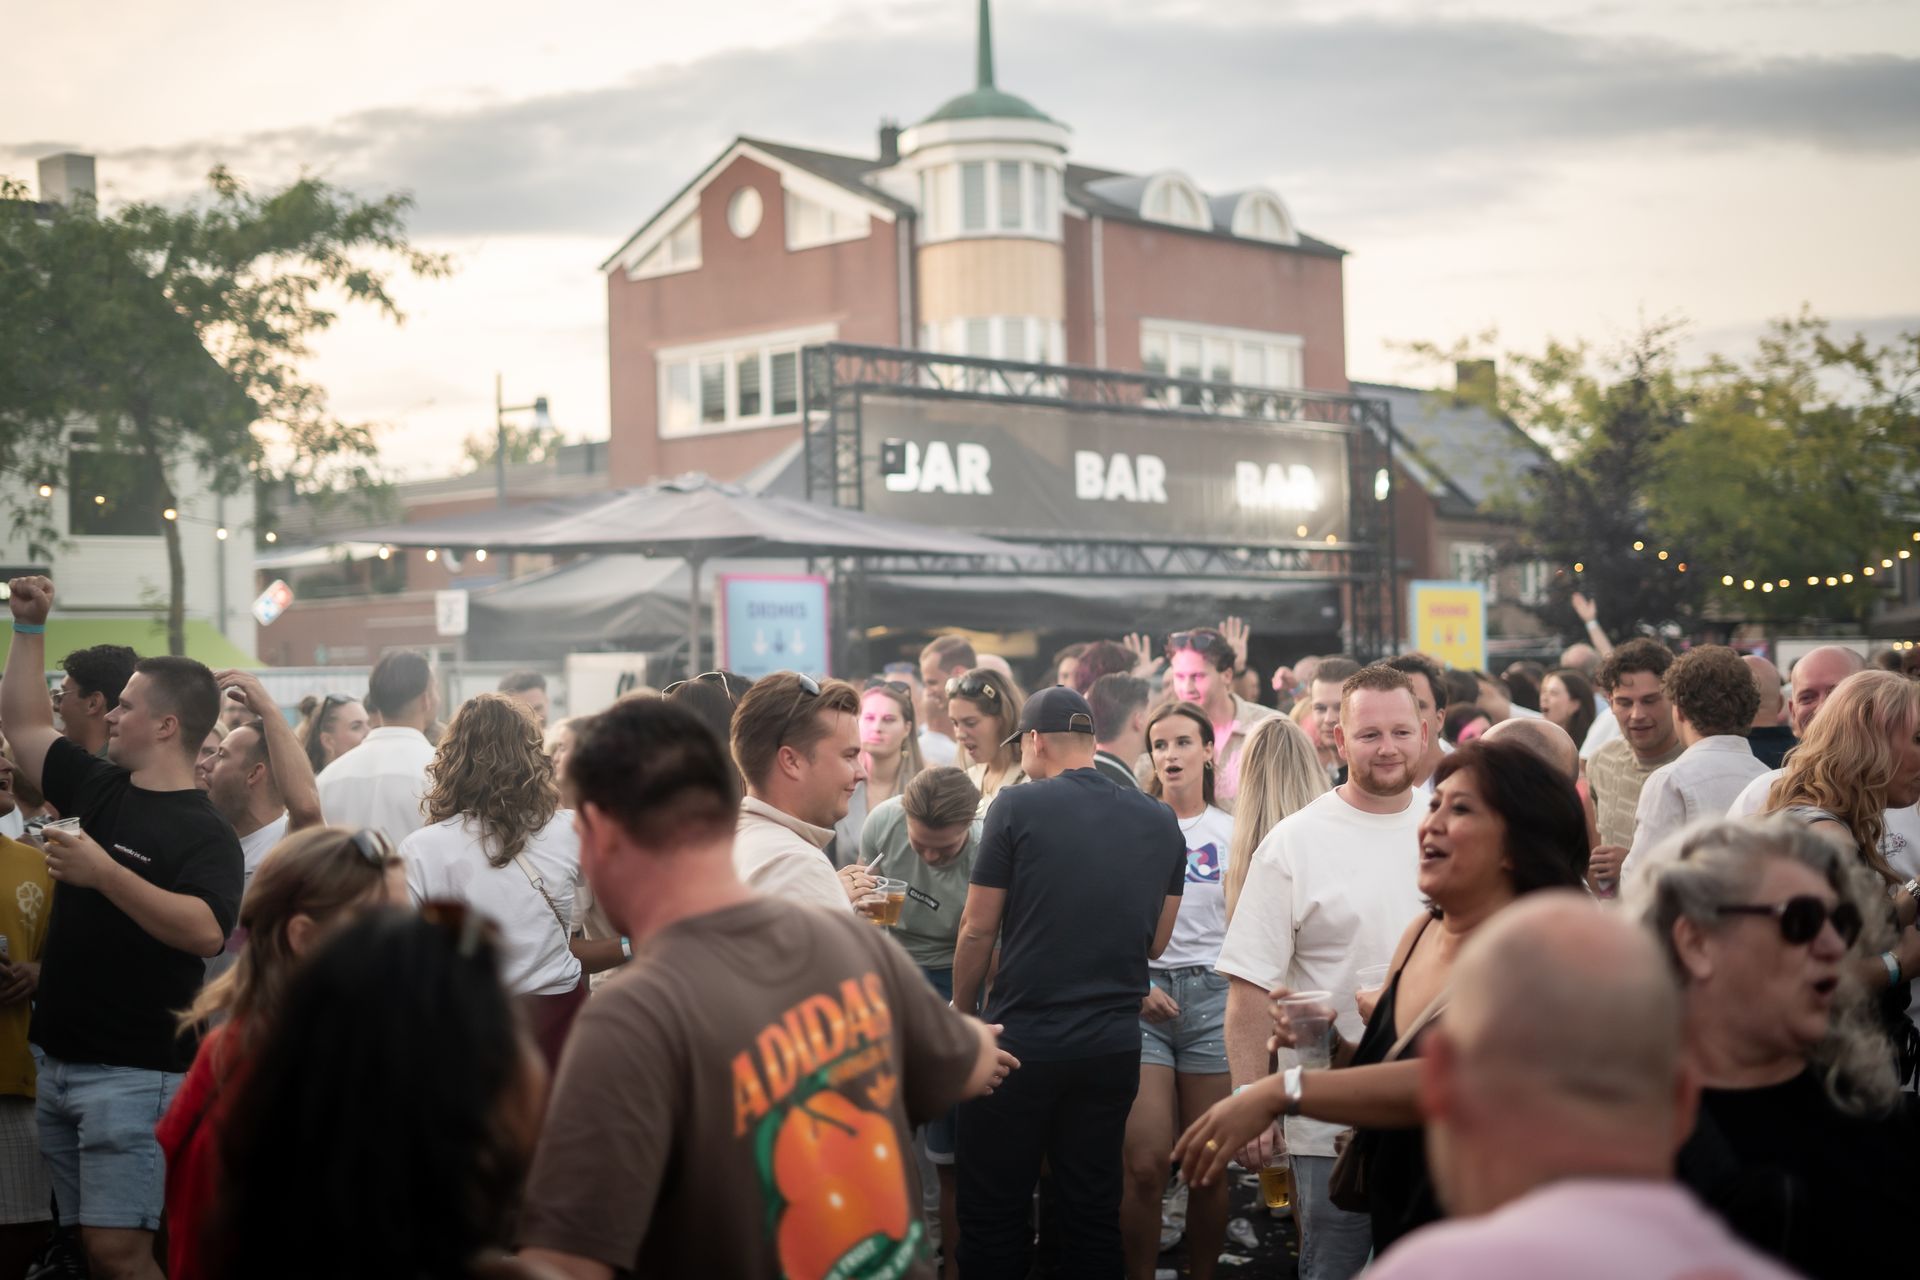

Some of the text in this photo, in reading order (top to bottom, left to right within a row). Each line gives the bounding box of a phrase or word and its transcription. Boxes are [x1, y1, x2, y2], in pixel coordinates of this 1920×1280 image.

[885, 441, 992, 495] BAR
[1075, 450, 1168, 504] BAR
[1235, 461, 1321, 512] BAR
